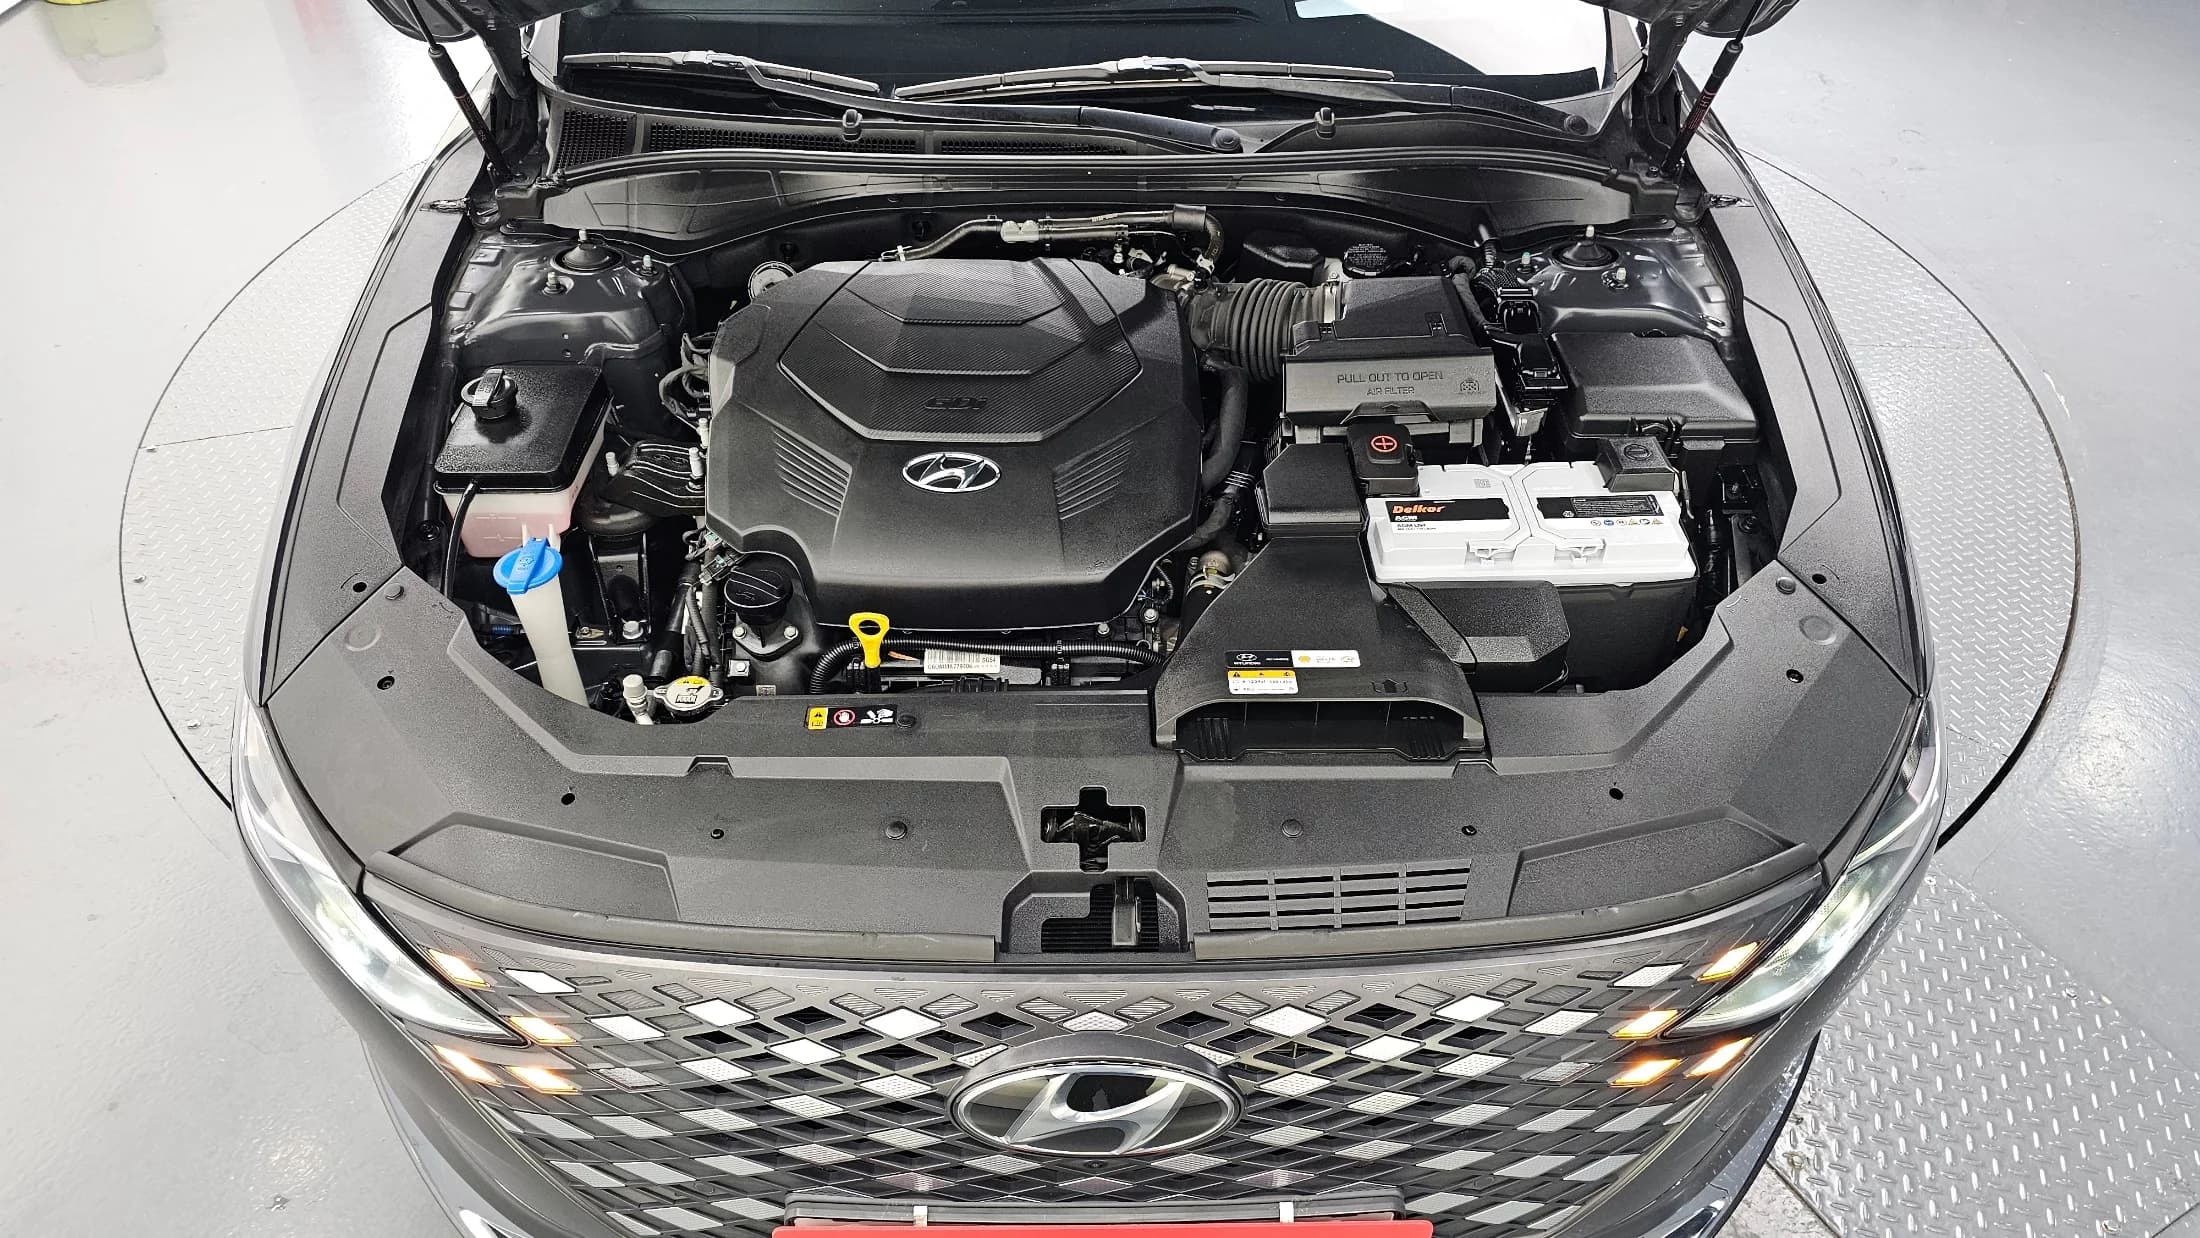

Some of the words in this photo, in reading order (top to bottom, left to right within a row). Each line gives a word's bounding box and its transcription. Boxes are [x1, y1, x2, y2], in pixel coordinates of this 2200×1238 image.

[1337, 373, 1366, 384] PULL
[1368, 372, 1391, 383] OUT
[1396, 372, 1410, 382] TO
[1412, 371, 1444, 381] OPEN
[1366, 387, 1382, 396] AIR
[1384, 386, 1415, 395] FILTER
[1392, 504, 1446, 514] Delkor
